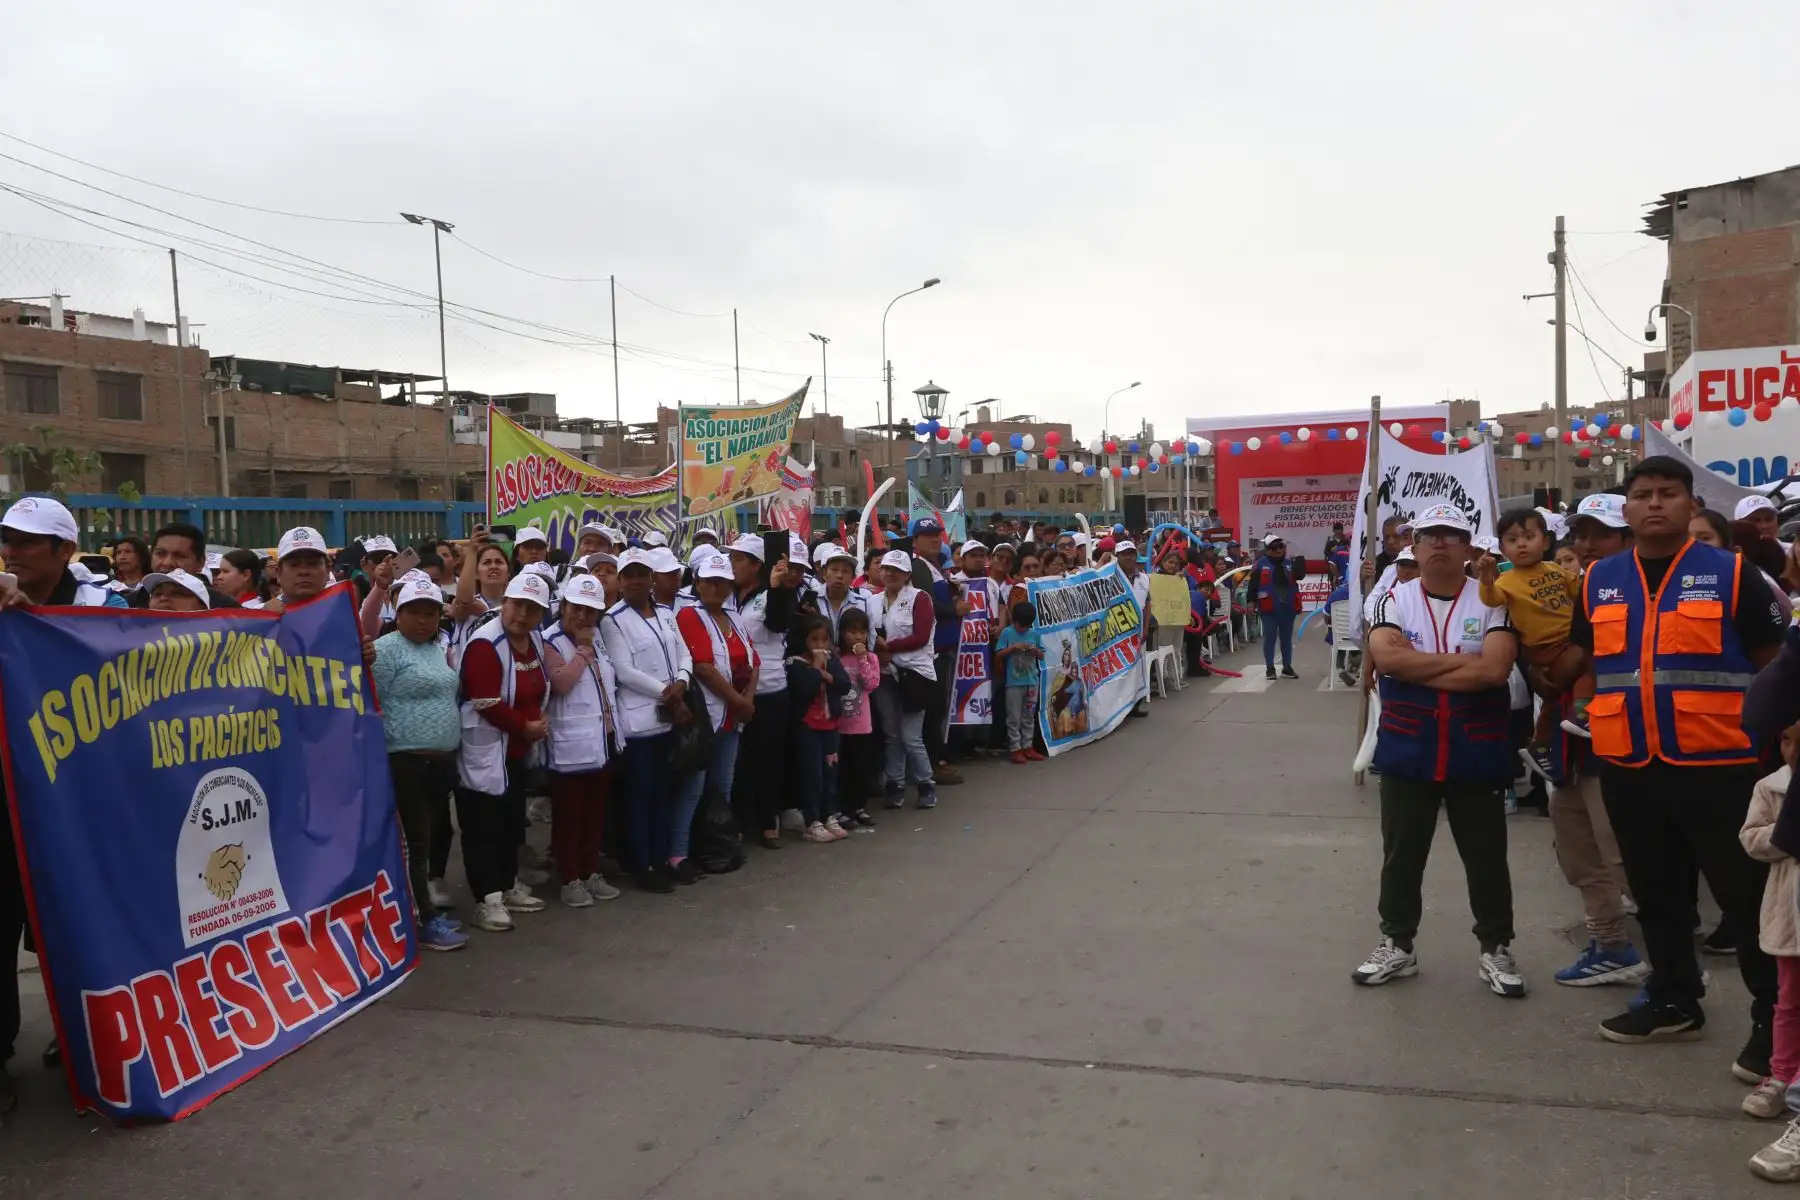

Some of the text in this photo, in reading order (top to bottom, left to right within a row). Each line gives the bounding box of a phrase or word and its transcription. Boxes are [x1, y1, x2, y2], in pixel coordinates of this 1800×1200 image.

[685, 414, 768, 439] ASOCIACIÓN
[1265, 493, 1290, 504] MÁS
[1292, 494, 1307, 503] DE
[1324, 493, 1341, 502] MIL
[1346, 492, 1359, 501] VE
[1280, 504, 1348, 513] BENEFICIADOS
[1266, 521, 1285, 529] SAN
[1274, 512, 1306, 521] PISTAS
[1320, 511, 1355, 519] VEREDA
[1598, 588, 1618, 600] SJM
[28, 626, 195, 784] ASOCIACIÓN
[190, 631, 222, 690] DE
[970, 698, 992, 717] SJM
[149, 718, 185, 768] LOS
[202, 798, 257, 831] S.J.M.
[188, 902, 229, 924] RESOLUCION
[189, 900, 277, 939] FUNDADA 06-09-2006
[81, 869, 407, 1108] PRESENTE
